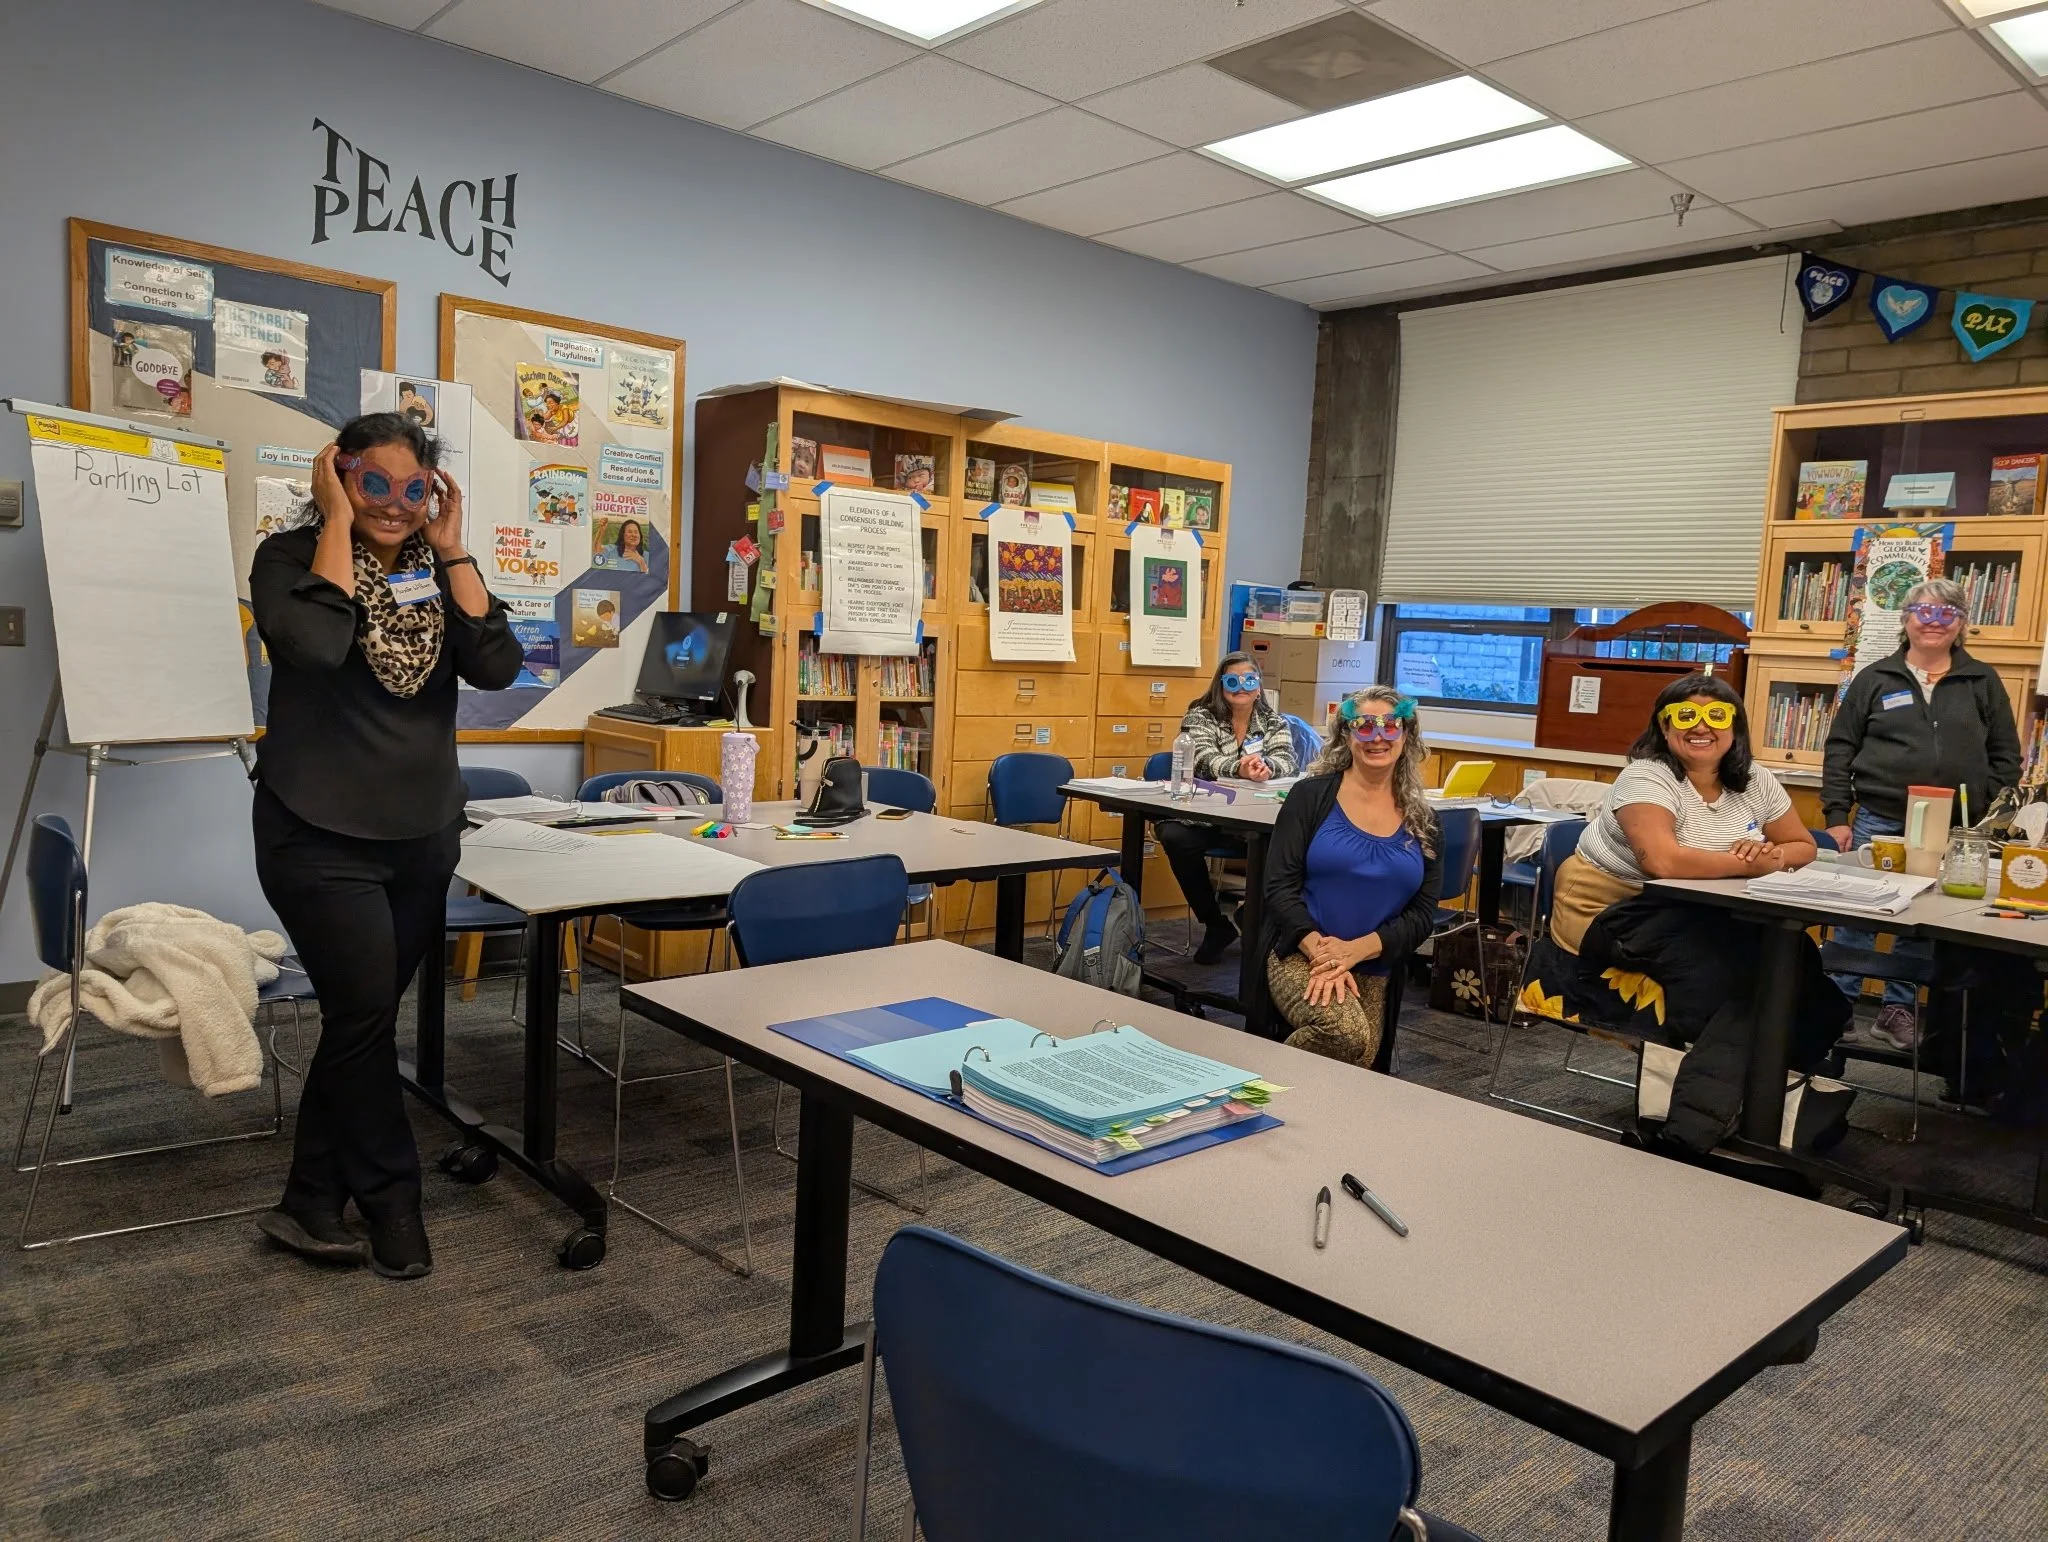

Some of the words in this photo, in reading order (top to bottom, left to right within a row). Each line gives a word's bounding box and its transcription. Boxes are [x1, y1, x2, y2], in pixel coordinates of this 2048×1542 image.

[112, 254, 171, 273] Knowledge
[1809, 269, 1845, 287] PEACE
[123, 281, 182, 299] Connection
[143, 295, 178, 309] Others
[1964, 311, 2012, 334] PAX
[550, 339, 593, 354] Imagination
[554, 349, 596, 363] Playfulness
[135, 360, 179, 376] GOODBYE
[261, 451, 278, 462] Joy
[292, 454, 313, 464] Dive
[604, 448, 633, 459] Creative
[634, 452, 662, 463] Conflict
[610, 464, 648, 475] Resolution
[75, 450, 161, 505] Parking
[166, 467, 203, 494] Lot
[533, 469, 583, 485] RAINBOW
[602, 472, 625, 481] Sense
[625, 474, 633, 482] of
[634, 475, 659, 485] Justice
[595, 492, 648, 506] DOLORES
[595, 502, 637, 515] HUERTA
[849, 506, 880, 516] ELEMENTS
[840, 514, 877, 525] CONSENSUS
[878, 518, 904, 529] BUILDING
[495, 525, 523, 537] MINE
[860, 525, 887, 535] PROCESS
[504, 538, 532, 548] MINE
[1883, 545, 1917, 553] GLOBAL
[495, 547, 523, 558] MINE
[1870, 552, 1928, 566] COMMUNITY
[495, 556, 559, 577] YOURS
[511, 609, 537, 617] Nature
[514, 624, 540, 634] Kitten
